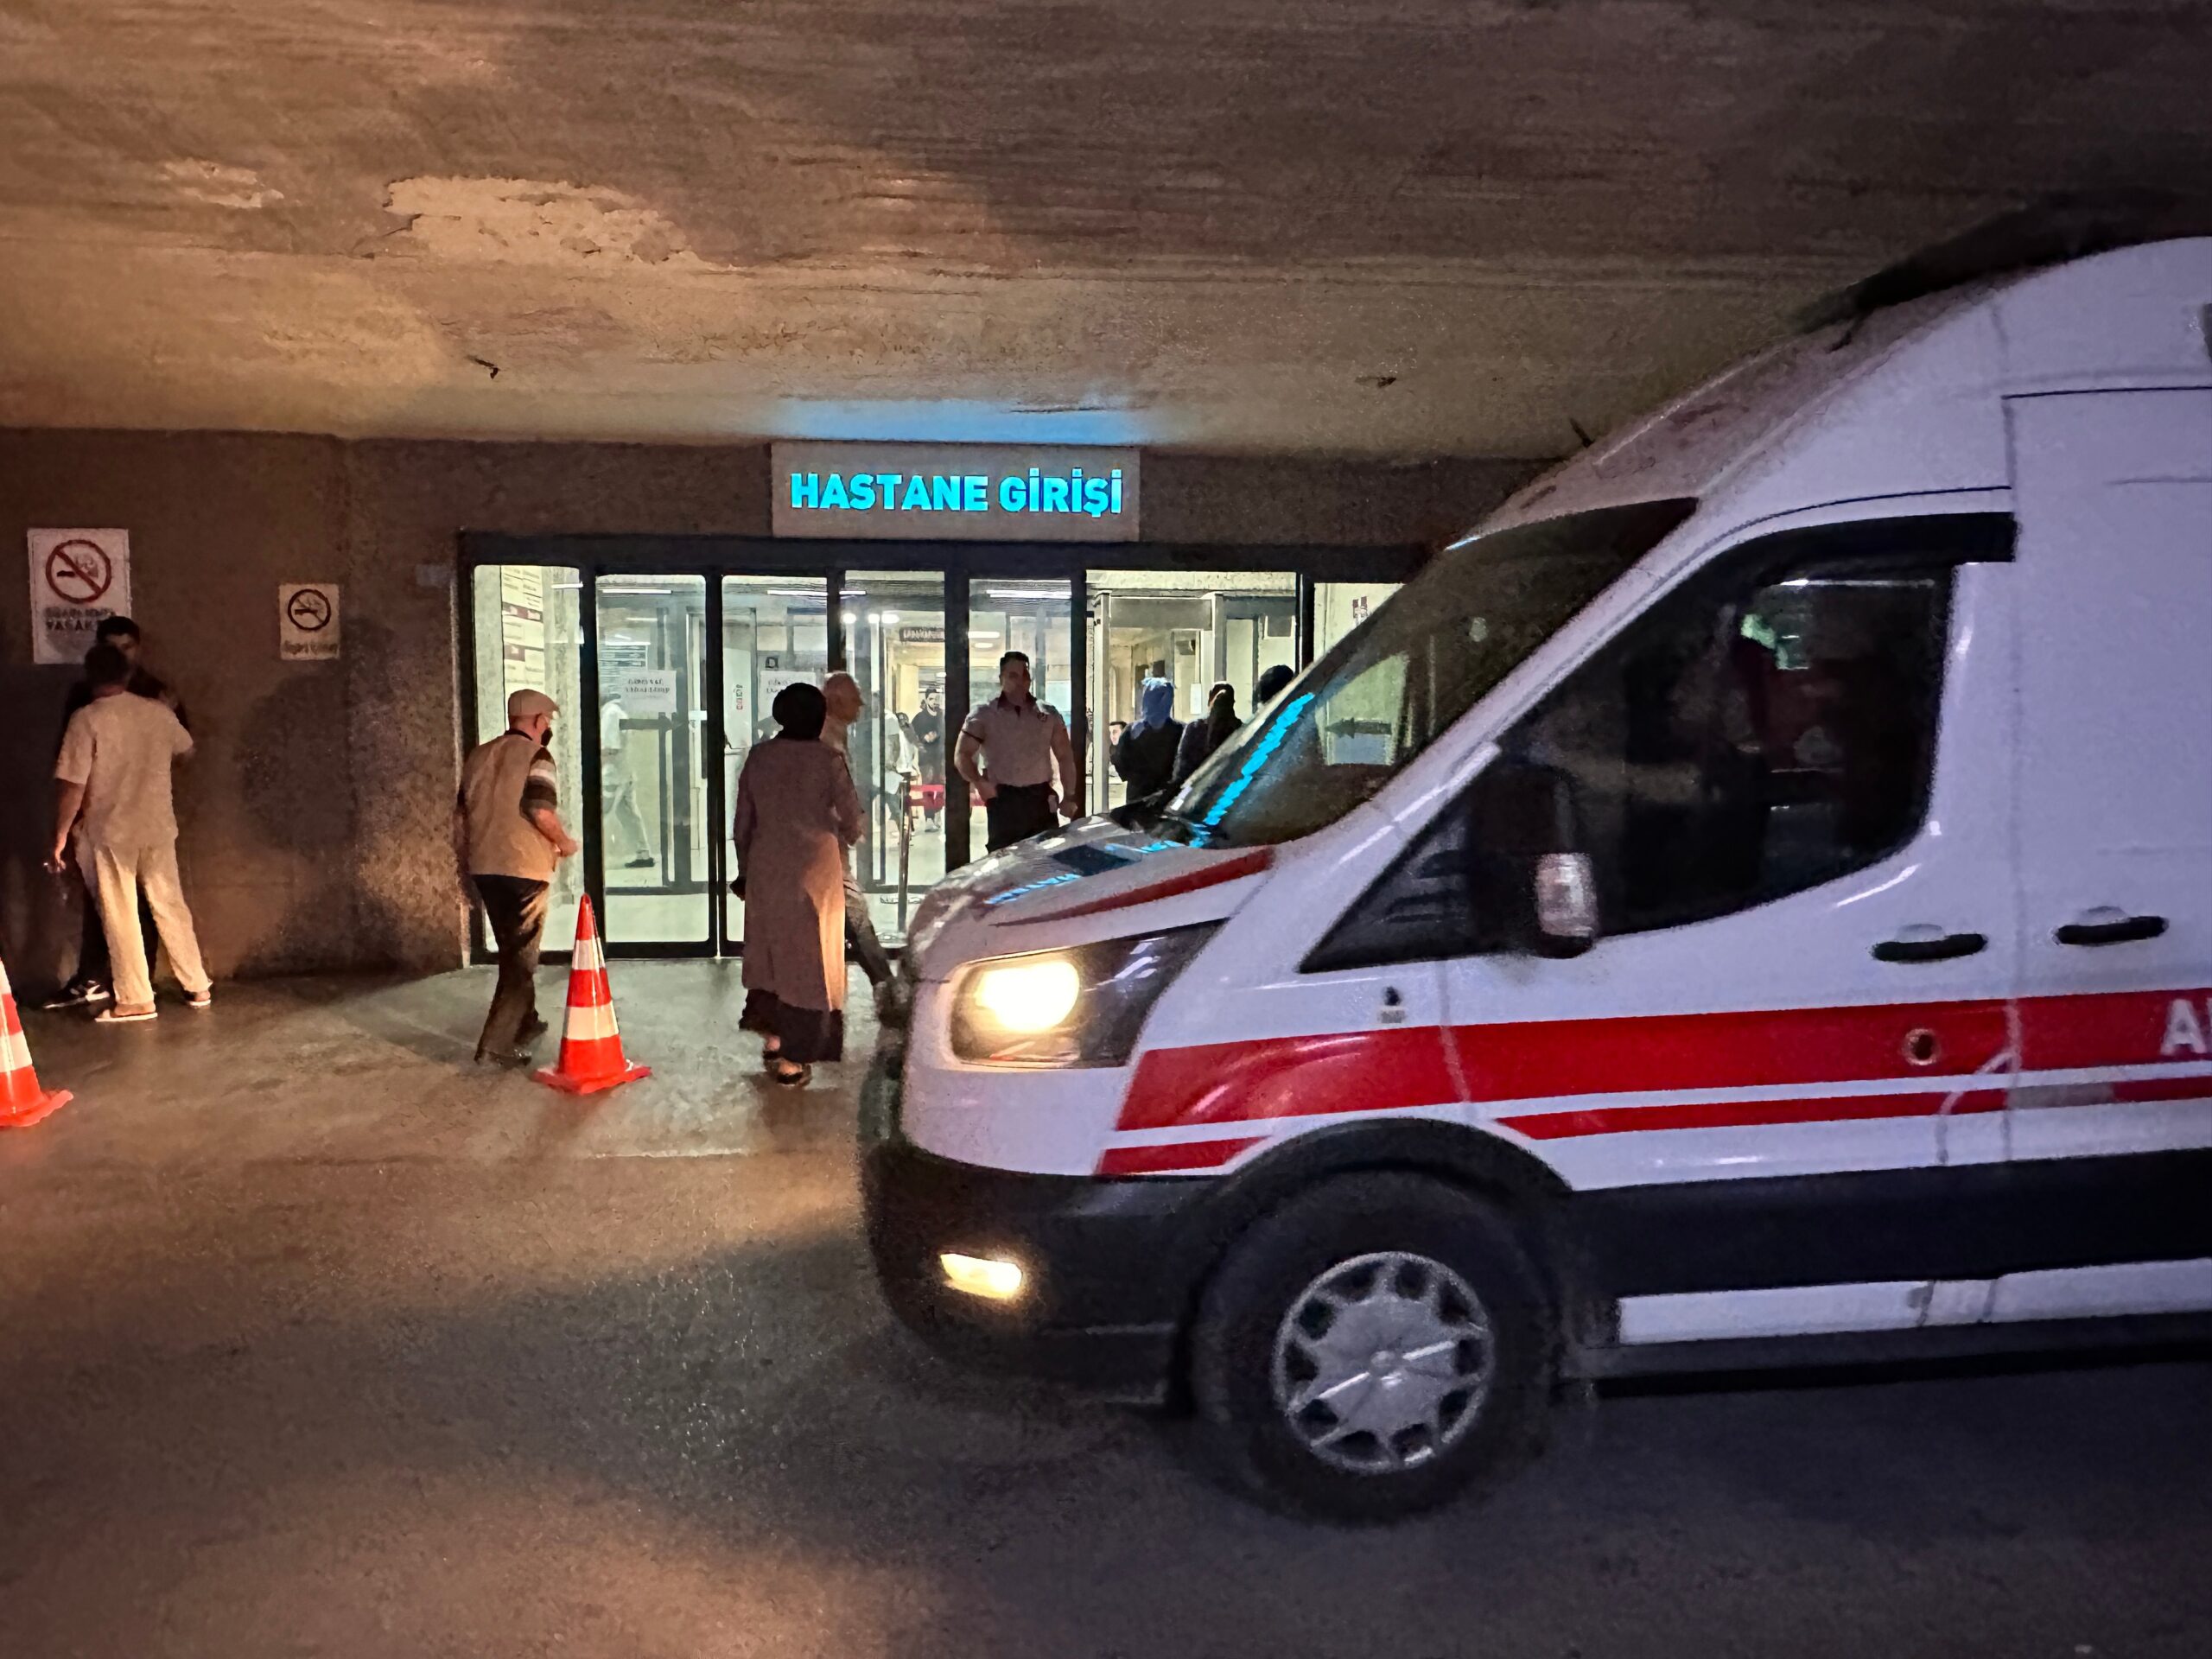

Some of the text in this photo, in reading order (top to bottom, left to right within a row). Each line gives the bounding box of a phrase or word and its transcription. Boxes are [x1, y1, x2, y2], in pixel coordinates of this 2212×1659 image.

[790, 467, 1122, 518] HASTANE GİRİŞİ
[2160, 998, 2212, 1056] A
